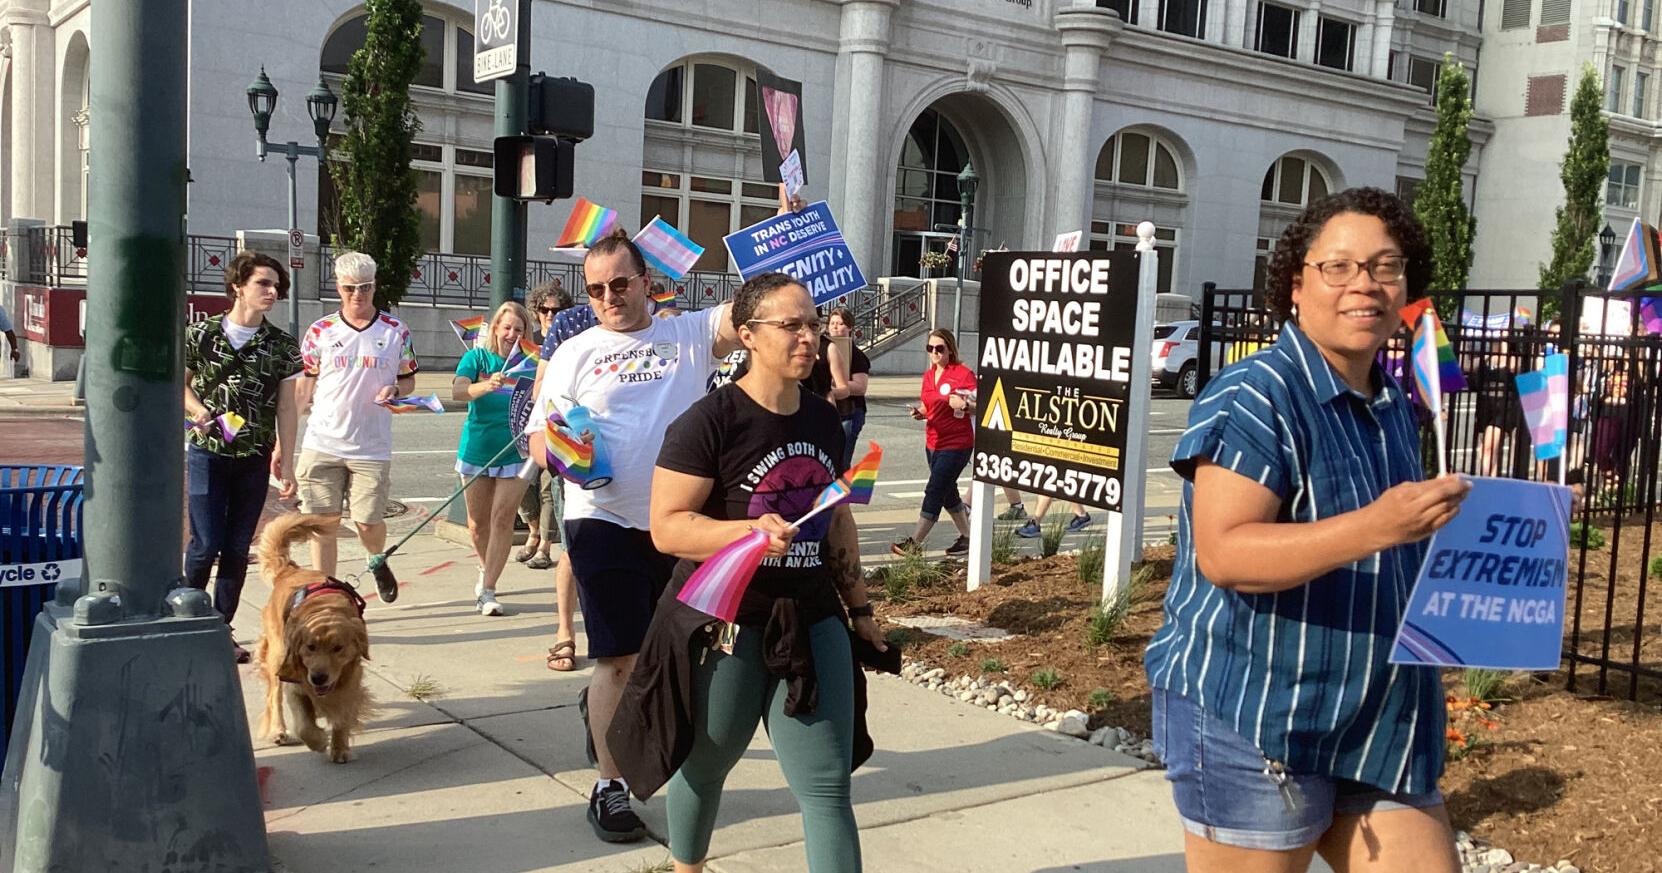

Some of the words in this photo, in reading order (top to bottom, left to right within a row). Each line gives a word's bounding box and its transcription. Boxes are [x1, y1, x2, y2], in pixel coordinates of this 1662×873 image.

[477, 54, 491, 73] BIKE
[494, 48, 513, 68] LANE
[751, 220, 792, 242] TRANS
[791, 210, 820, 228] YOUTH
[753, 242, 769, 256] IN
[769, 235, 788, 250] NC
[787, 221, 827, 242] DESERVE
[775, 247, 834, 279] GNITY
[1009, 258, 1110, 294] OFFICE
[1012, 299, 1101, 336] SPACE
[619, 371, 662, 382] PRIDE
[981, 337, 1131, 382] AVAILABLE
[1056, 385, 1080, 398] THE
[1015, 391, 1120, 433] ALSTON
[1038, 422, 1063, 438] Realty
[1063, 427, 1087, 442] Group
[740, 483, 753, 492] I
[747, 447, 785, 484] SWING
[787, 441, 815, 456] BOTH
[976, 452, 1120, 505] 336-272-5779
[1479, 514, 1547, 548] STOP
[761, 556, 781, 567] ITH
[785, 556, 801, 568] AN
[803, 556, 822, 567] AXE
[1428, 549, 1564, 588] EXTREMISM
[1422, 591, 1456, 617] AT
[1460, 594, 1505, 622] THE
[1507, 598, 1555, 624] NCGA
